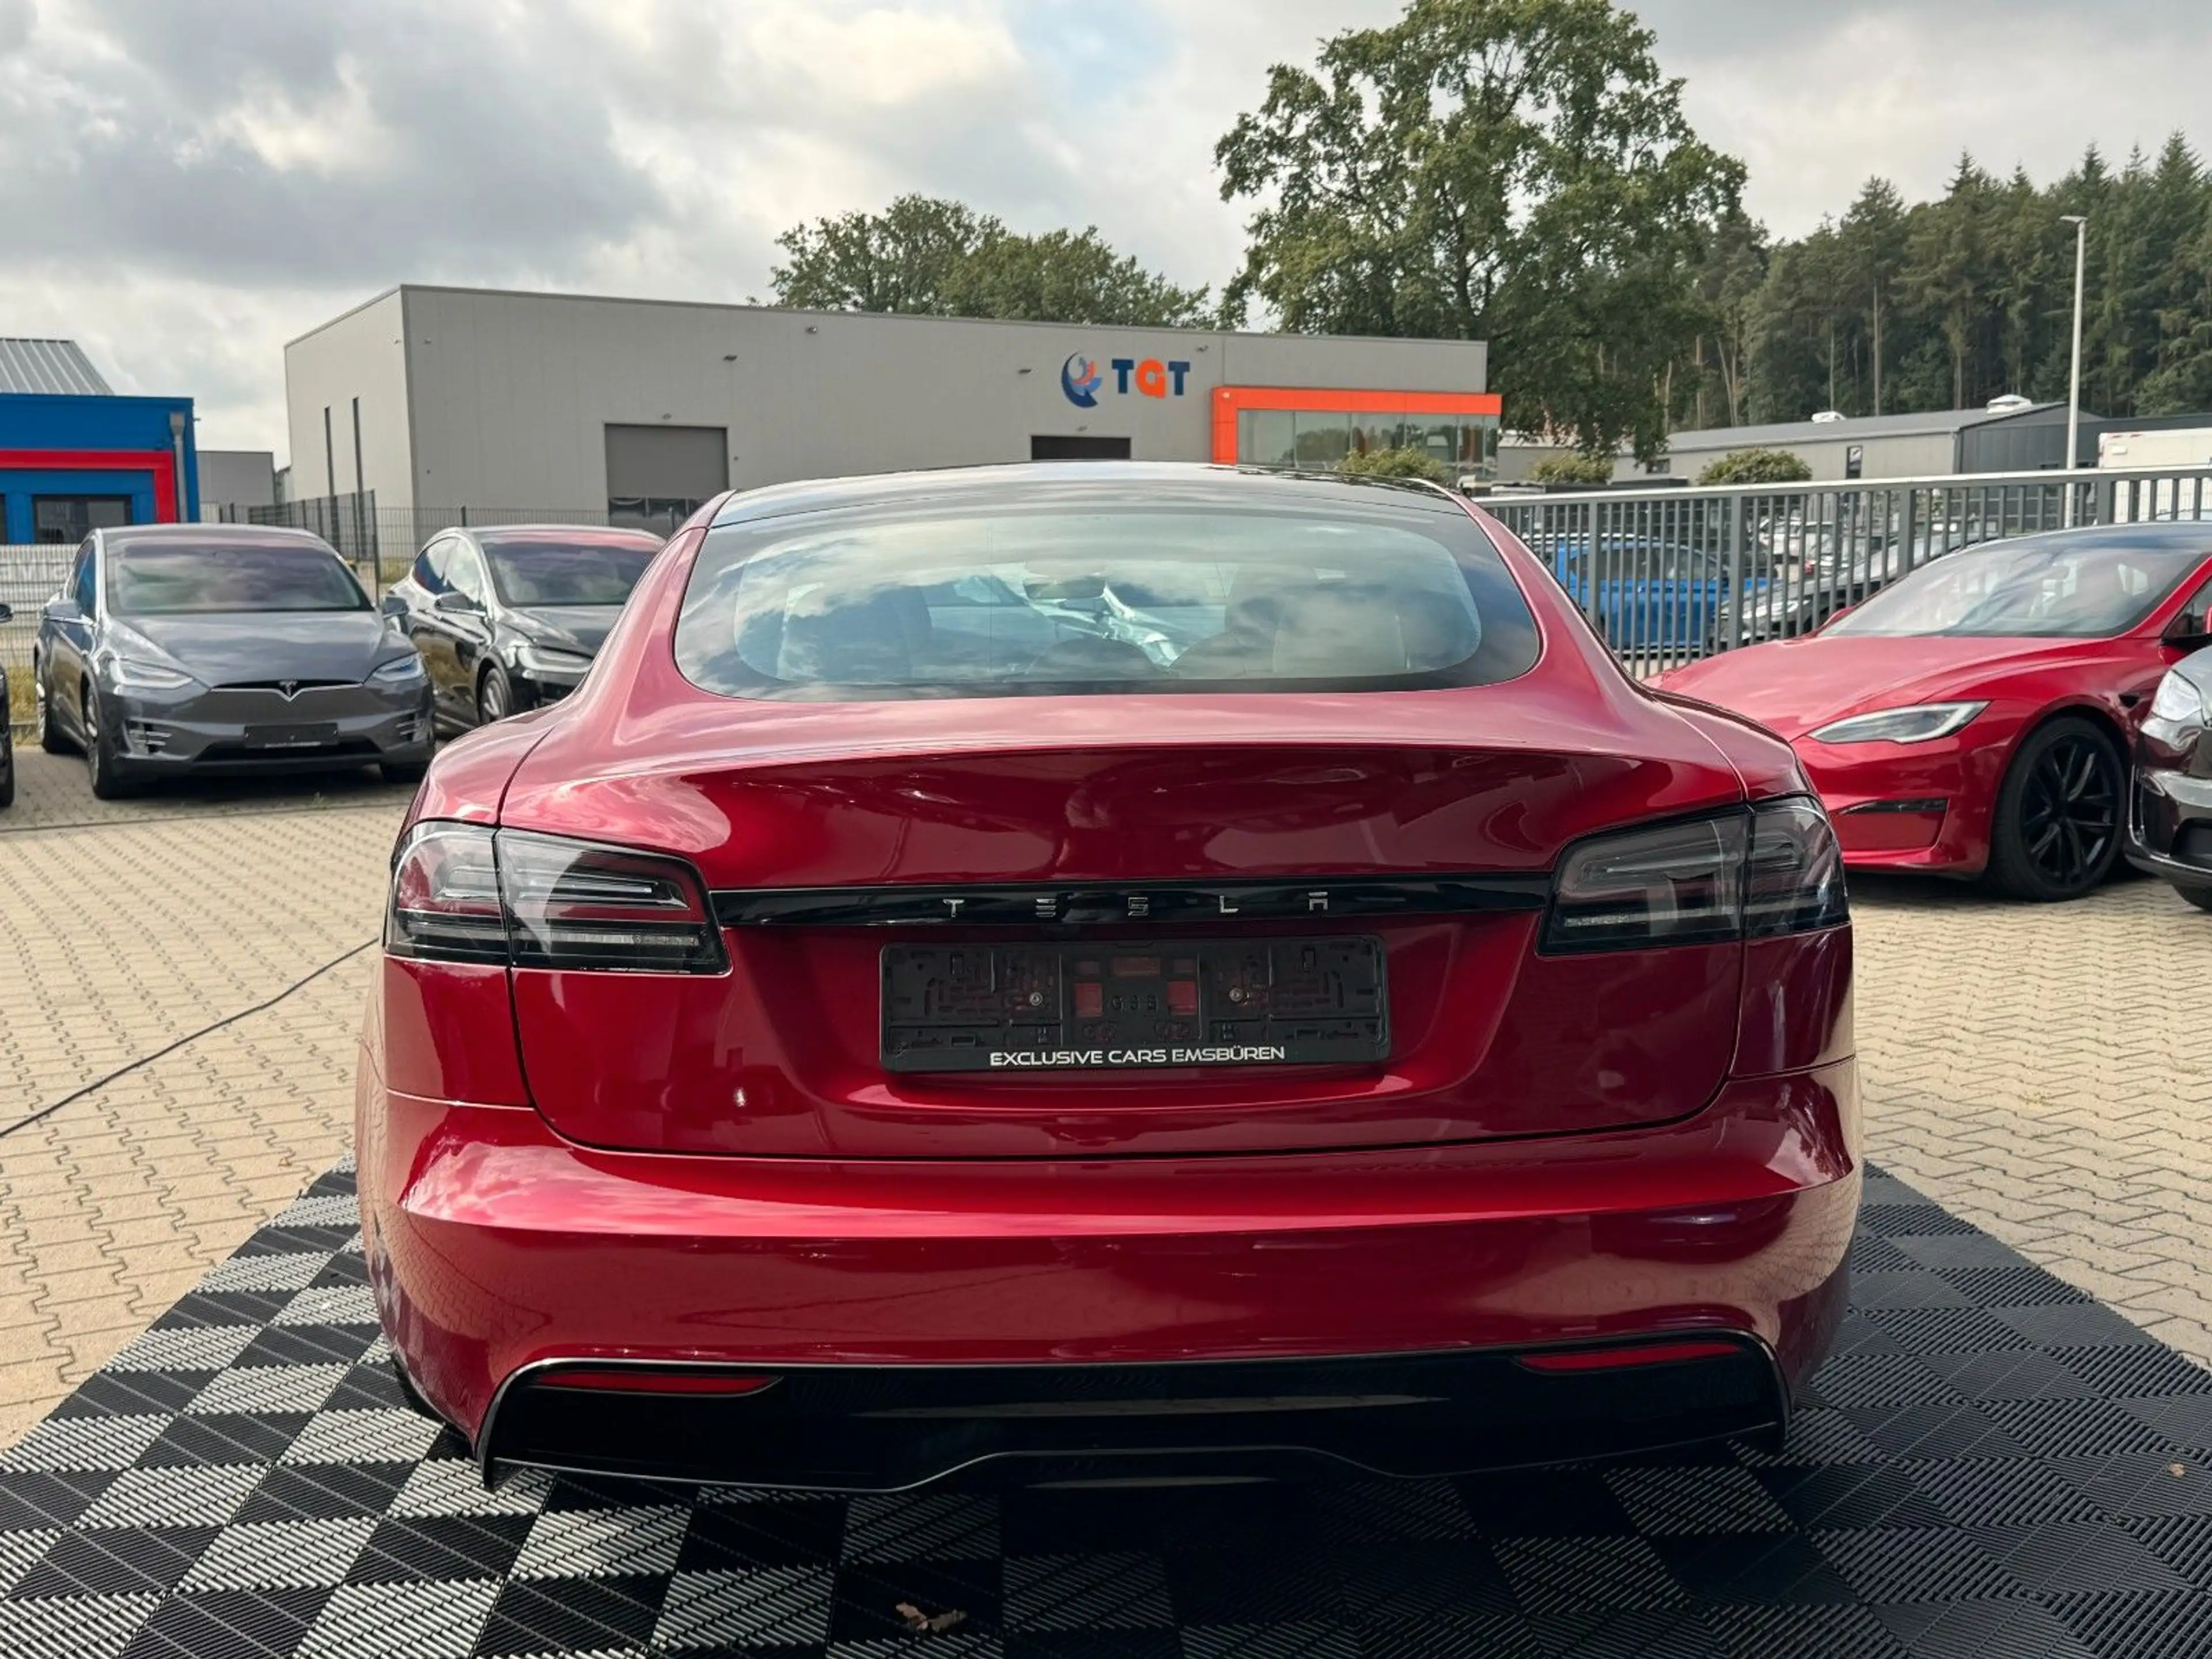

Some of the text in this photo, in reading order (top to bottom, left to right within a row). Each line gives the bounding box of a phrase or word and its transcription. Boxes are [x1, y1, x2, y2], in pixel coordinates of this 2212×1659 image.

[1112, 358, 1191, 399] TGT
[942, 891, 1328, 918] TESLA
[990, 1045, 1285, 1066] EXCLUSIVE CARS EMSBÜREN
